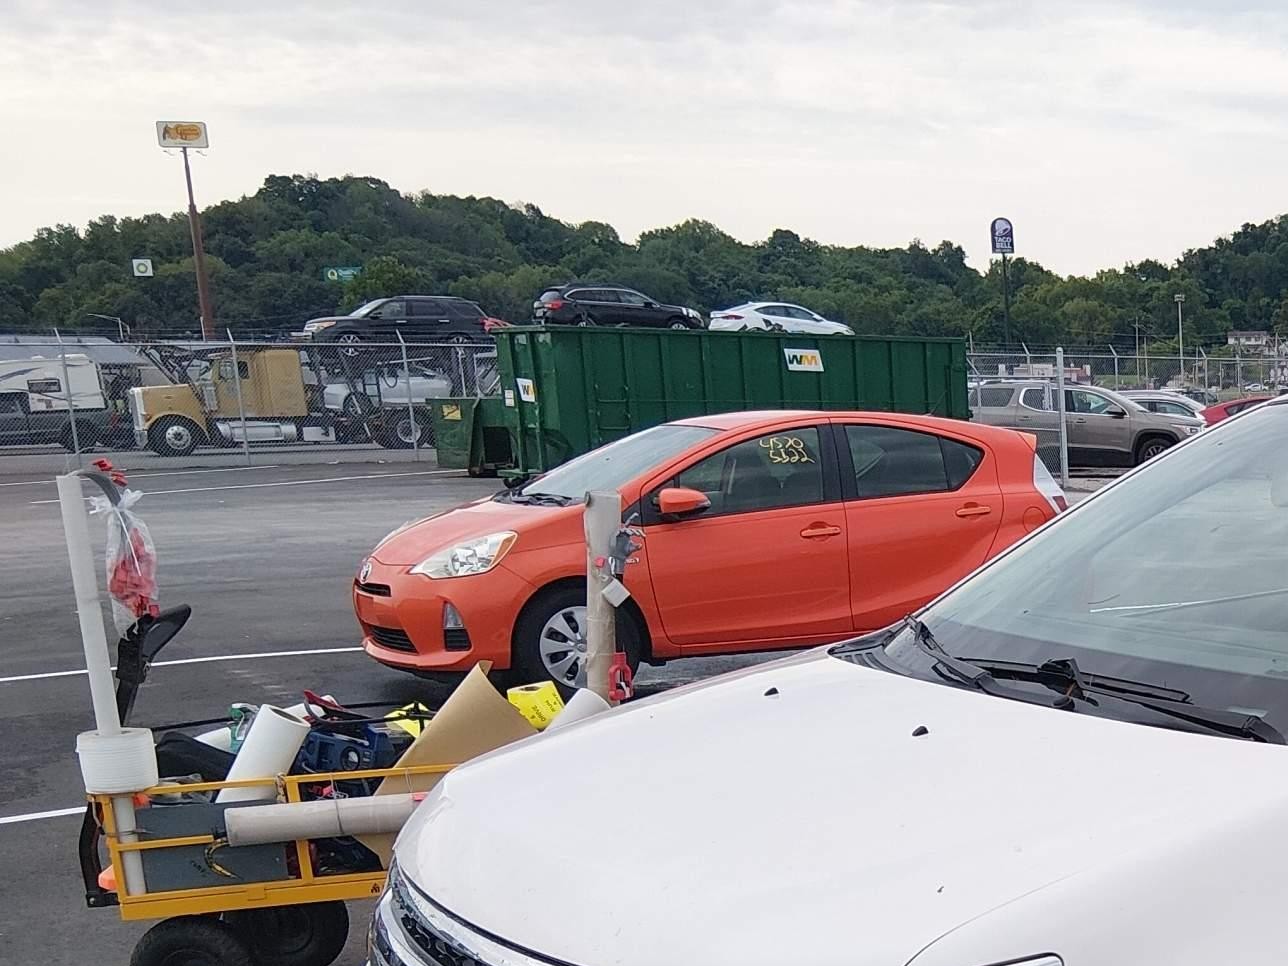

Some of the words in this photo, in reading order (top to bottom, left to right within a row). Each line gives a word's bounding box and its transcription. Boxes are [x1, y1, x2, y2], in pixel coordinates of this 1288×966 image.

[788, 354, 818, 366] WM
[759, 437, 804, 449] 4570
[769, 448, 816, 464] 5522
